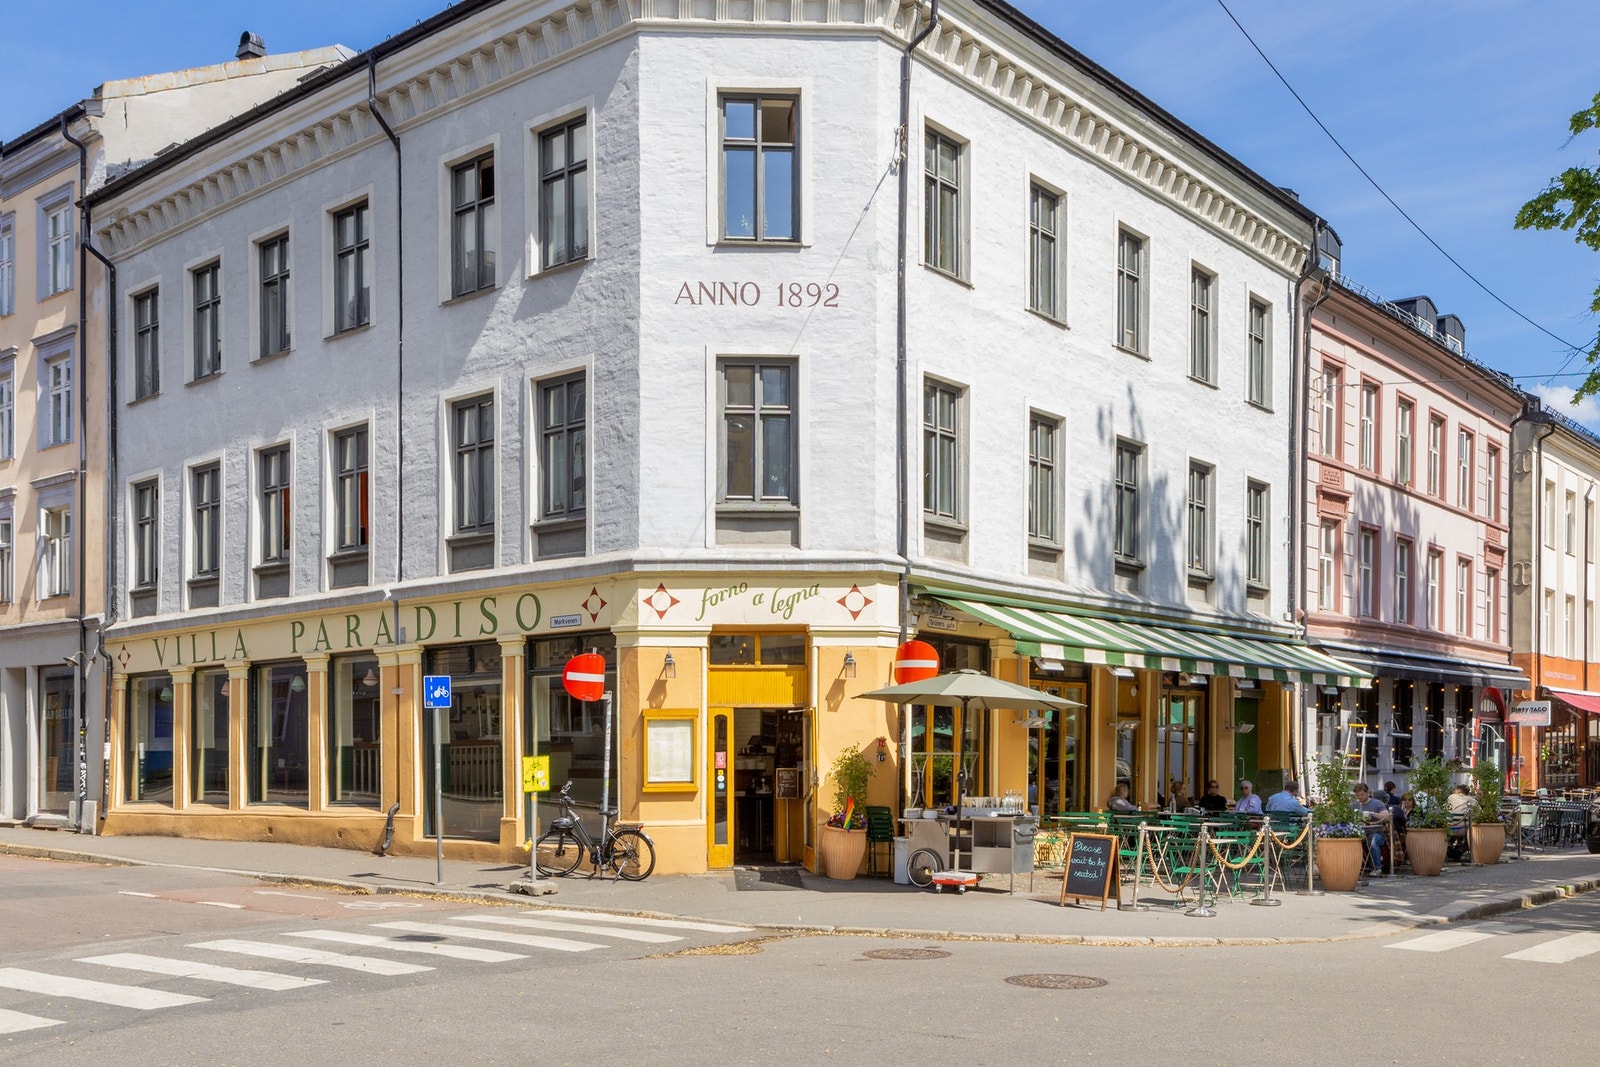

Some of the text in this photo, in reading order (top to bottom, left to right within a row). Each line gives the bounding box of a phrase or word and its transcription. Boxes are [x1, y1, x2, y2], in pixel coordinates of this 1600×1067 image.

[673, 281, 839, 308] ANNO 1892
[695, 582, 820, 621] forno a legna
[152, 592, 541, 667] VILLA PARADISO
[553, 617, 578, 626] Markveien
[1073, 840, 1103, 854] Please
[1071, 856, 1106, 868] wait to be
